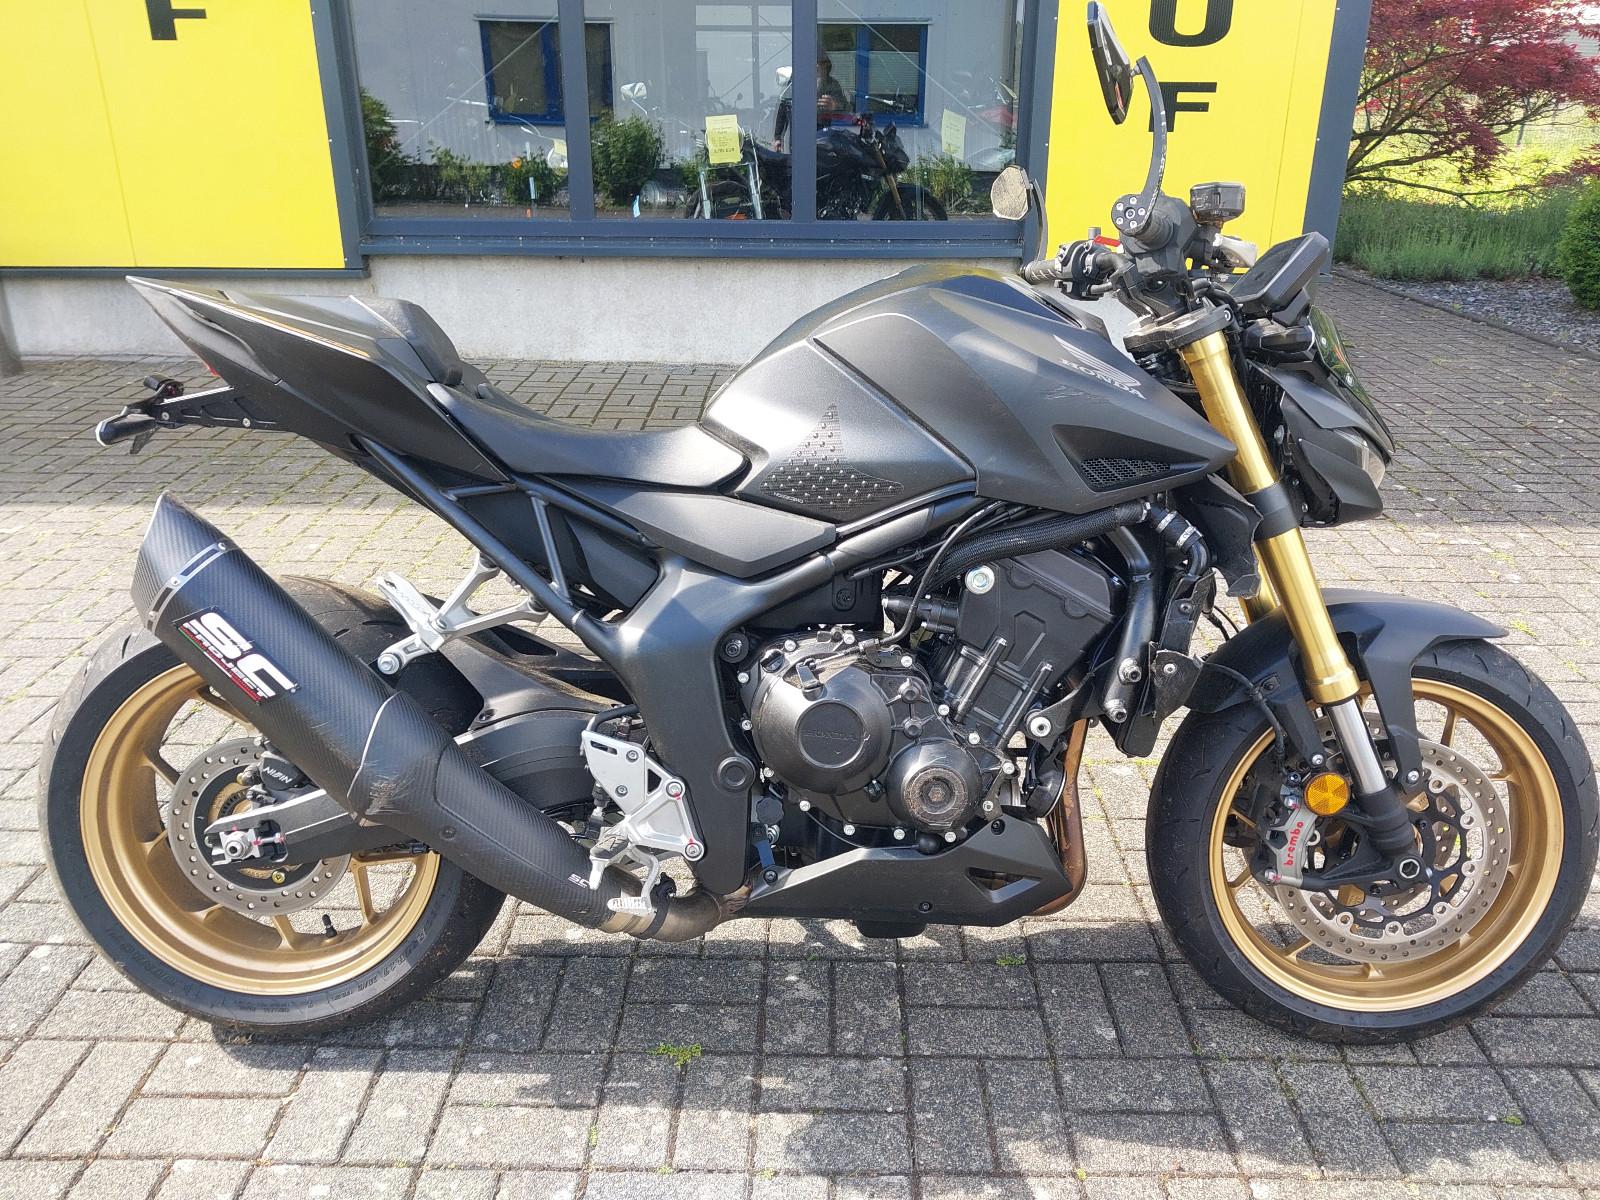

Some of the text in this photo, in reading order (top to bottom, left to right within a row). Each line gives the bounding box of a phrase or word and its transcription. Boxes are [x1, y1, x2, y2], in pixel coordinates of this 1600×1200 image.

[1061, 358, 1146, 399] HONDA
[188, 612, 296, 698] SC
[1283, 821, 1304, 866] brembo
